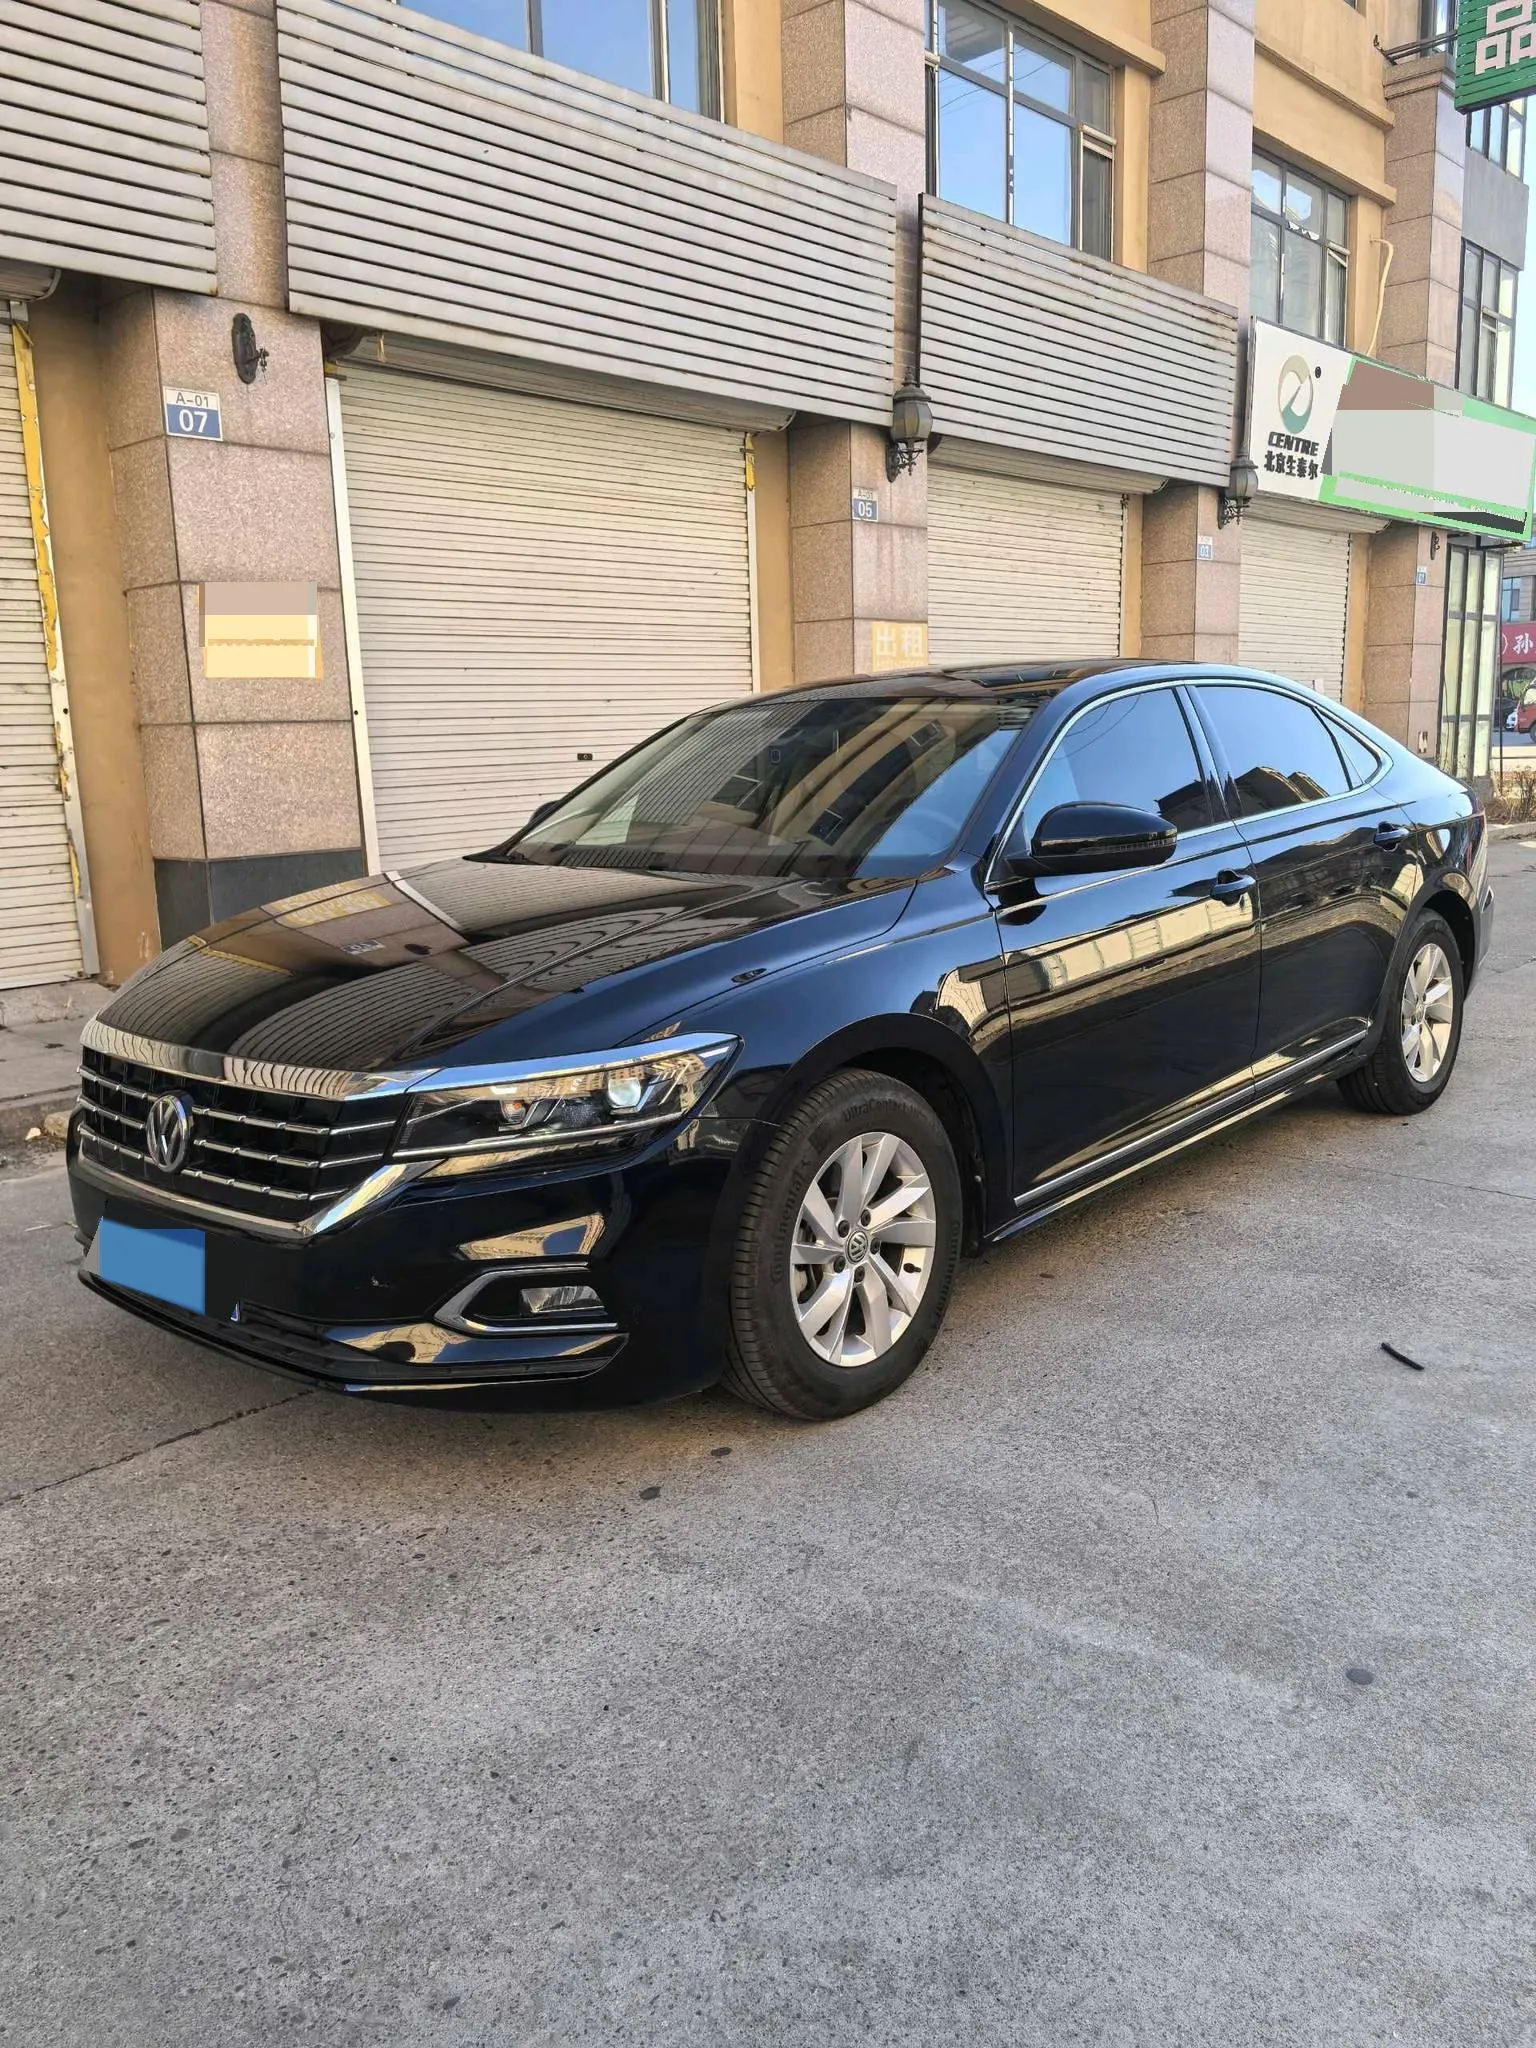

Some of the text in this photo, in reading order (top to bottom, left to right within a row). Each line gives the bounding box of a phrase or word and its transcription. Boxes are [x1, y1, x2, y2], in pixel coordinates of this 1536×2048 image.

[1475, 0, 1536, 75] 品
[176, 392, 209, 408] A-01
[179, 409, 208, 433] 07
[1268, 432, 1319, 456] CENTRE
[858, 501, 872, 517] 05
[876, 624, 924, 657] 出租
